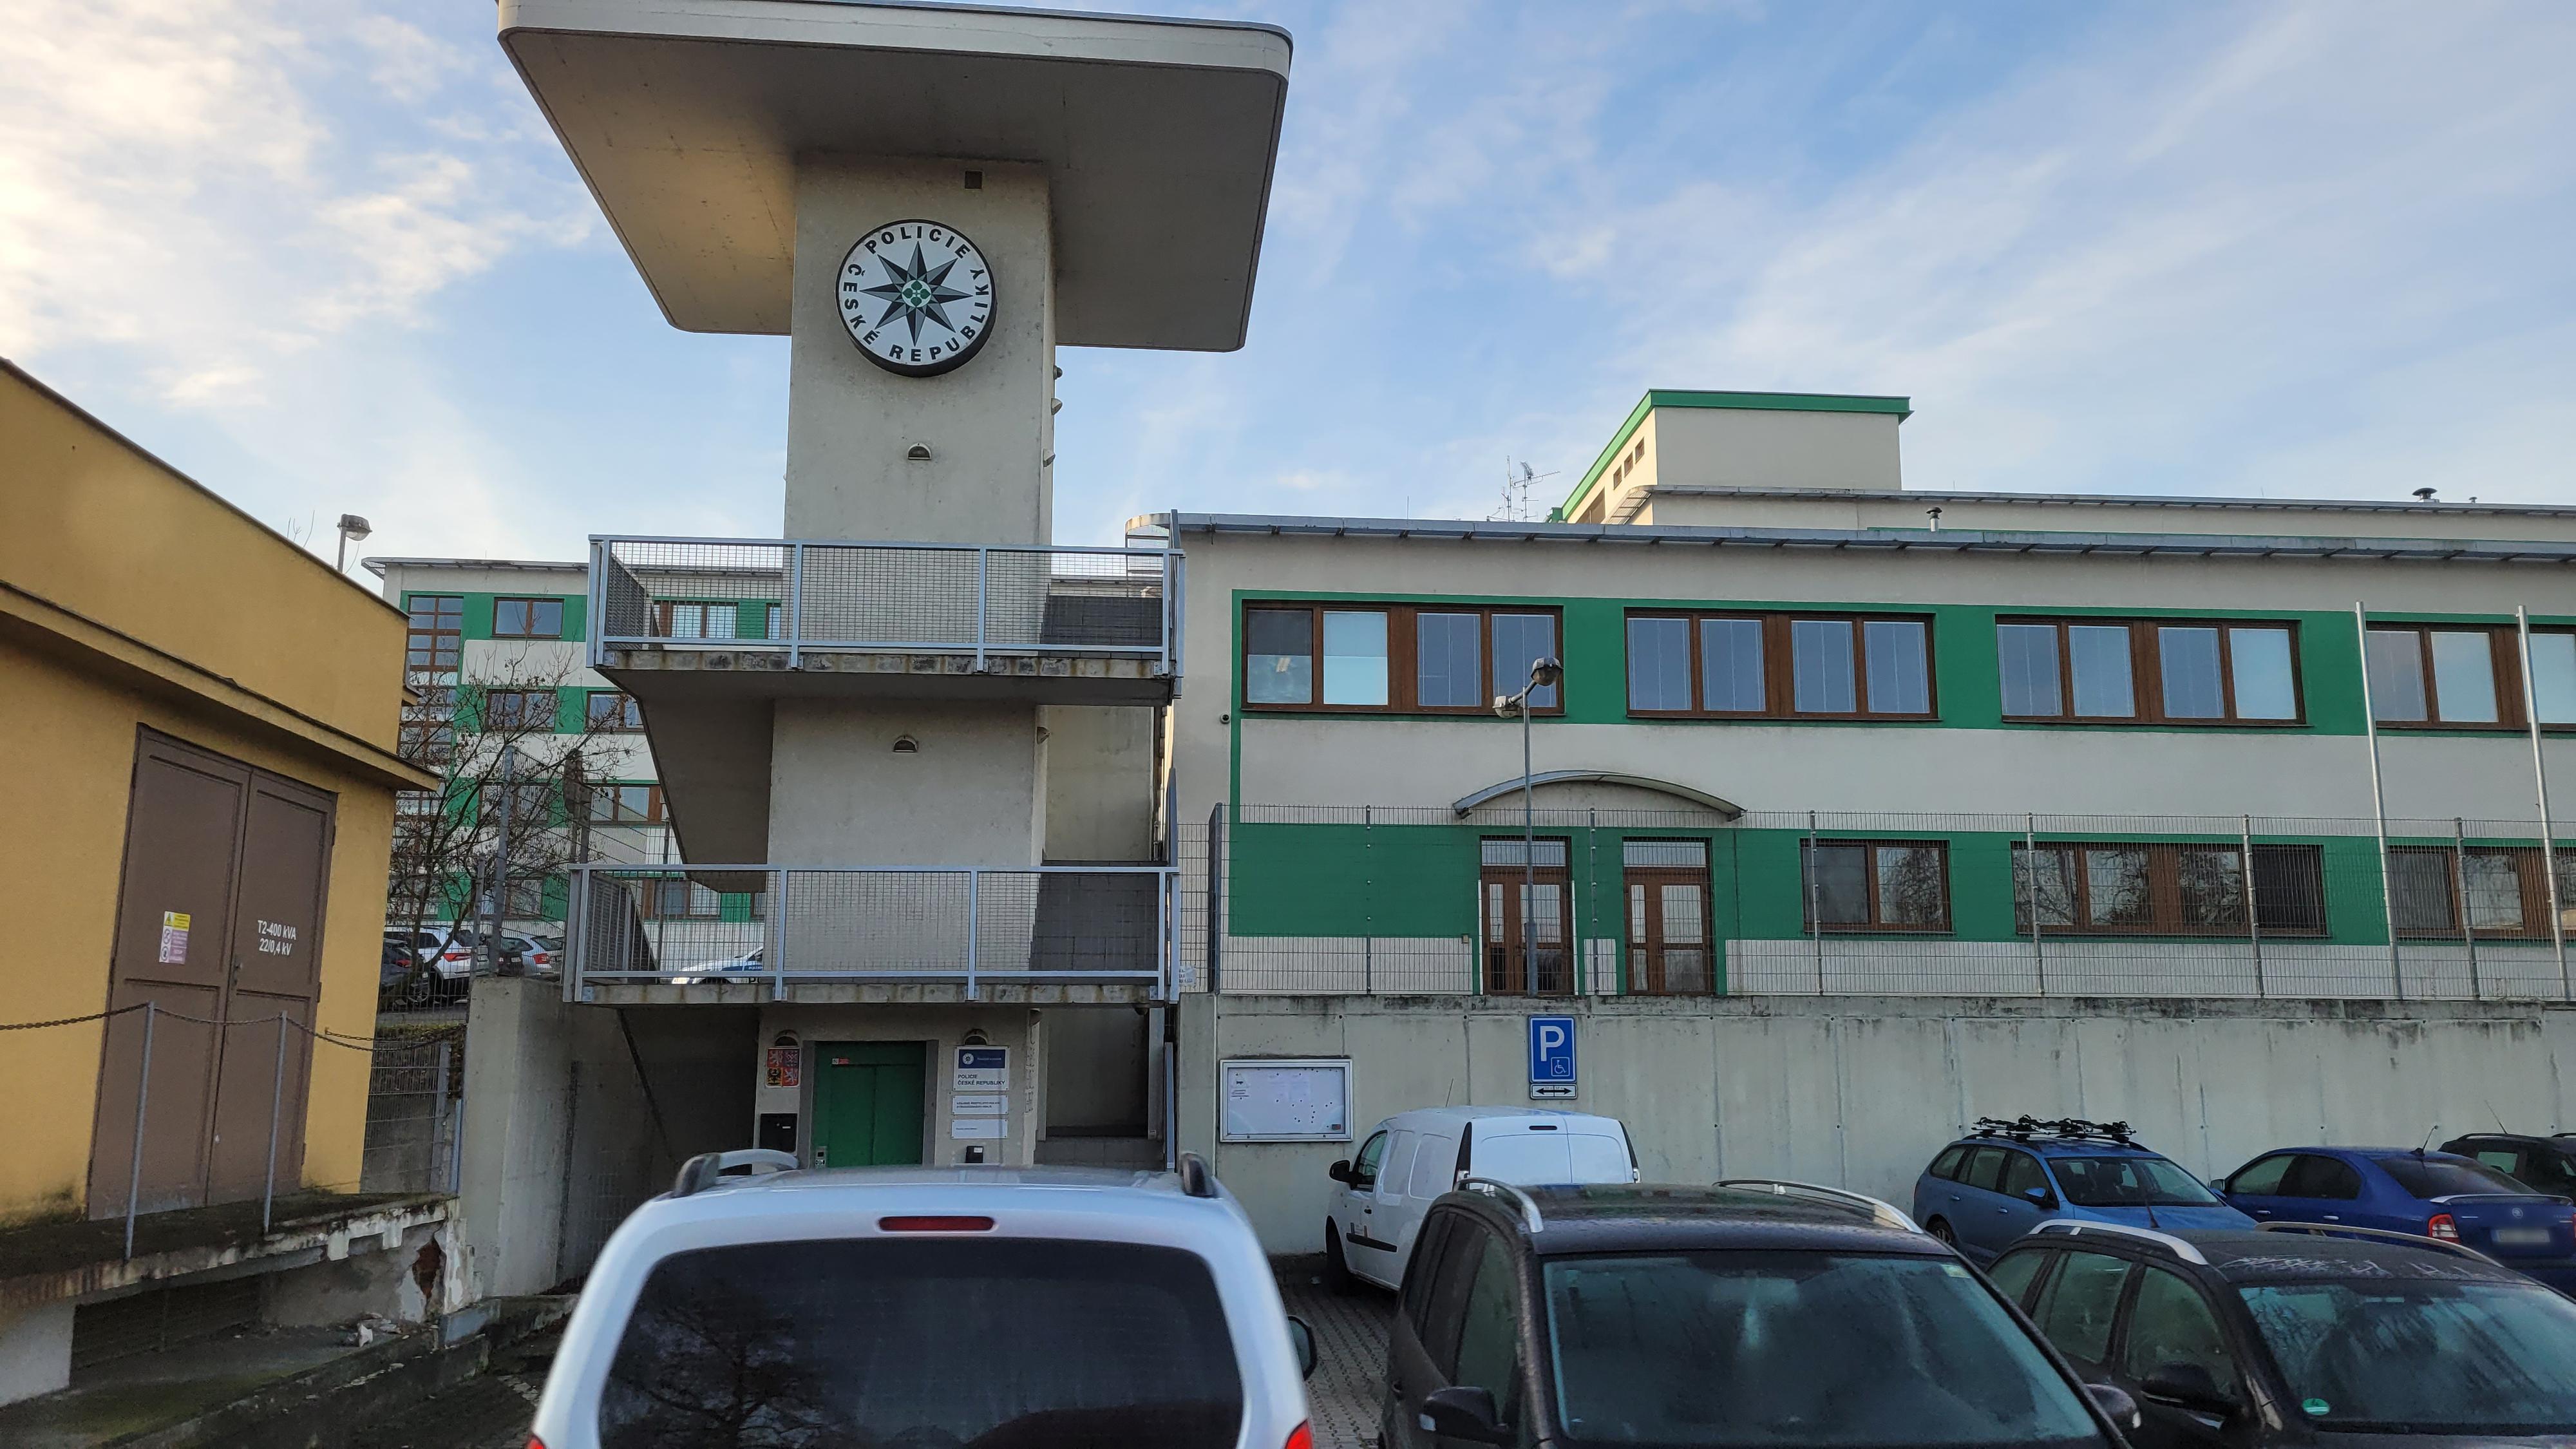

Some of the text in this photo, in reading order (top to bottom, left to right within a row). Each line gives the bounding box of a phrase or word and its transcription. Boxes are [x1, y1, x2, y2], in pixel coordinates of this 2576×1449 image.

[864, 226, 971, 259] POLICIE
[843, 263, 990, 362] ČESKÉ REPUBLIKY
[258, 920, 296, 940] T2-400 kVA
[281, 942, 293, 956] kV
[1540, 1025, 1565, 1062] P
